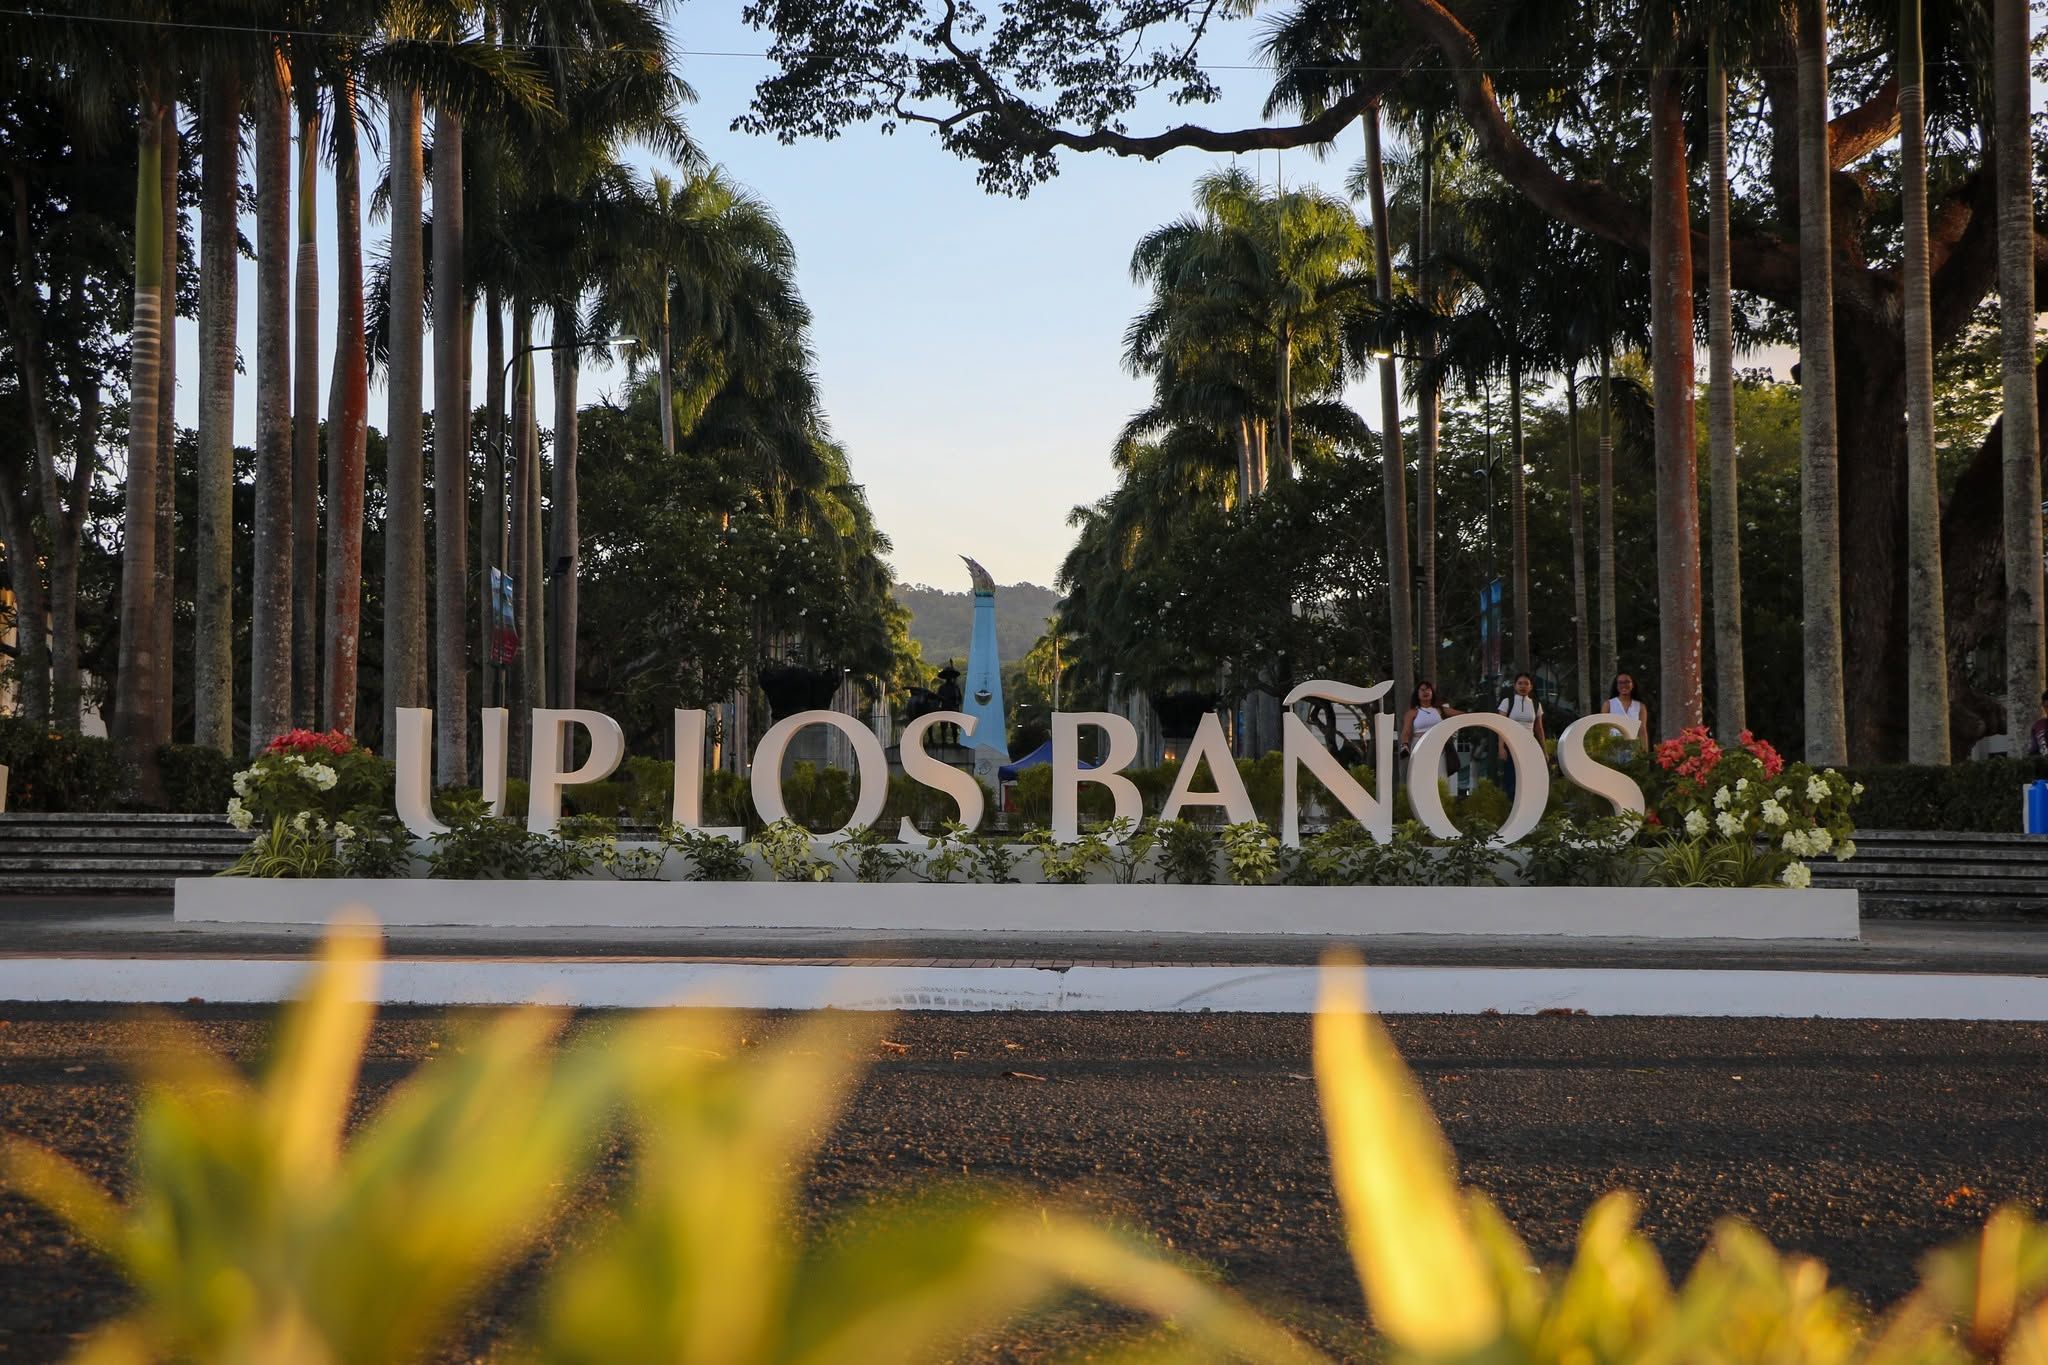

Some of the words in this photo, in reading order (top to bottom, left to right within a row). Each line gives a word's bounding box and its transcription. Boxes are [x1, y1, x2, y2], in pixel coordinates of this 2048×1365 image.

[395, 706, 625, 839] UP
[672, 708, 984, 844] LOS
[1051, 680, 1646, 848] BAÑOS
